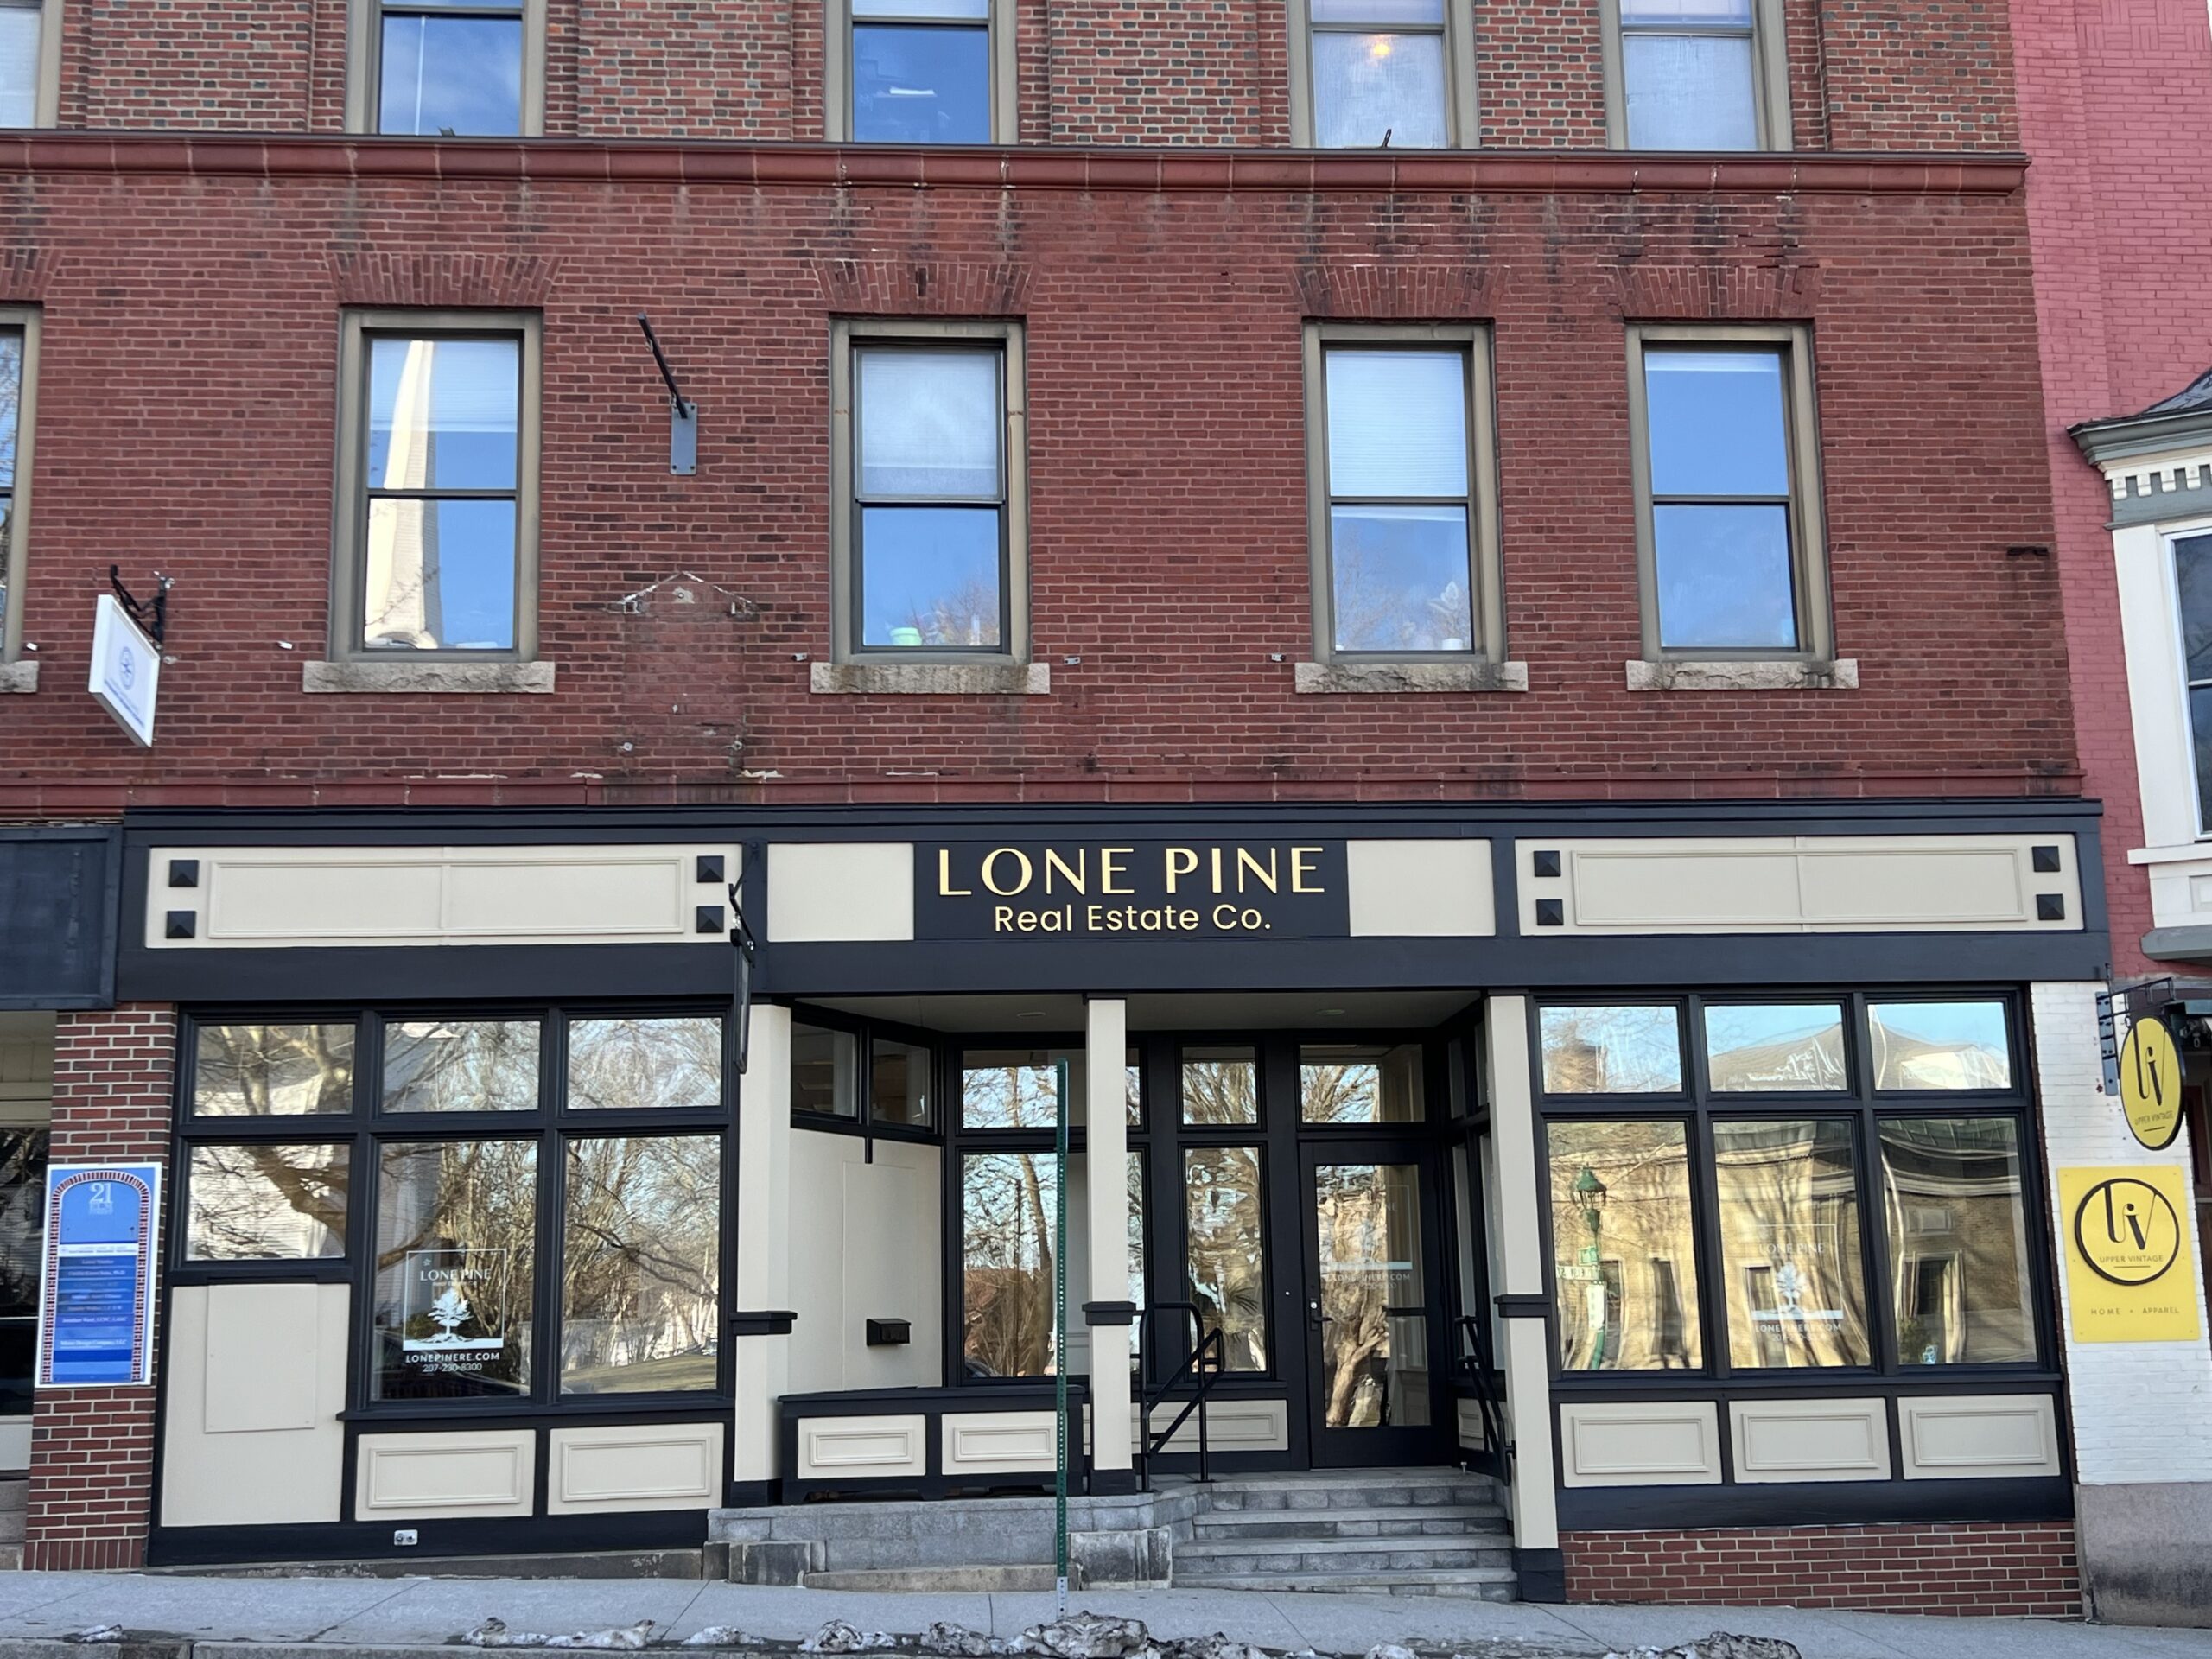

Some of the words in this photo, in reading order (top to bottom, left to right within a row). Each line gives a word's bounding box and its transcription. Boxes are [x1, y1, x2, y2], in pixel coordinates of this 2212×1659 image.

[938, 847, 1135, 896] LONE
[1165, 847, 1325, 895] PINE
[994, 904, 1072, 932] Real
[1087, 904, 1199, 931] Estate
[1212, 904, 1272, 931] Co.
[89, 1182, 112, 1203] 21
[2127, 1254, 2164, 1262] VINTAGE
[419, 1269, 458, 1281] LONE
[460, 1268, 491, 1280] PINE
[2090, 1307, 2121, 1316] HOME
[405, 1352, 500, 1363] LONEPINERE.COM
